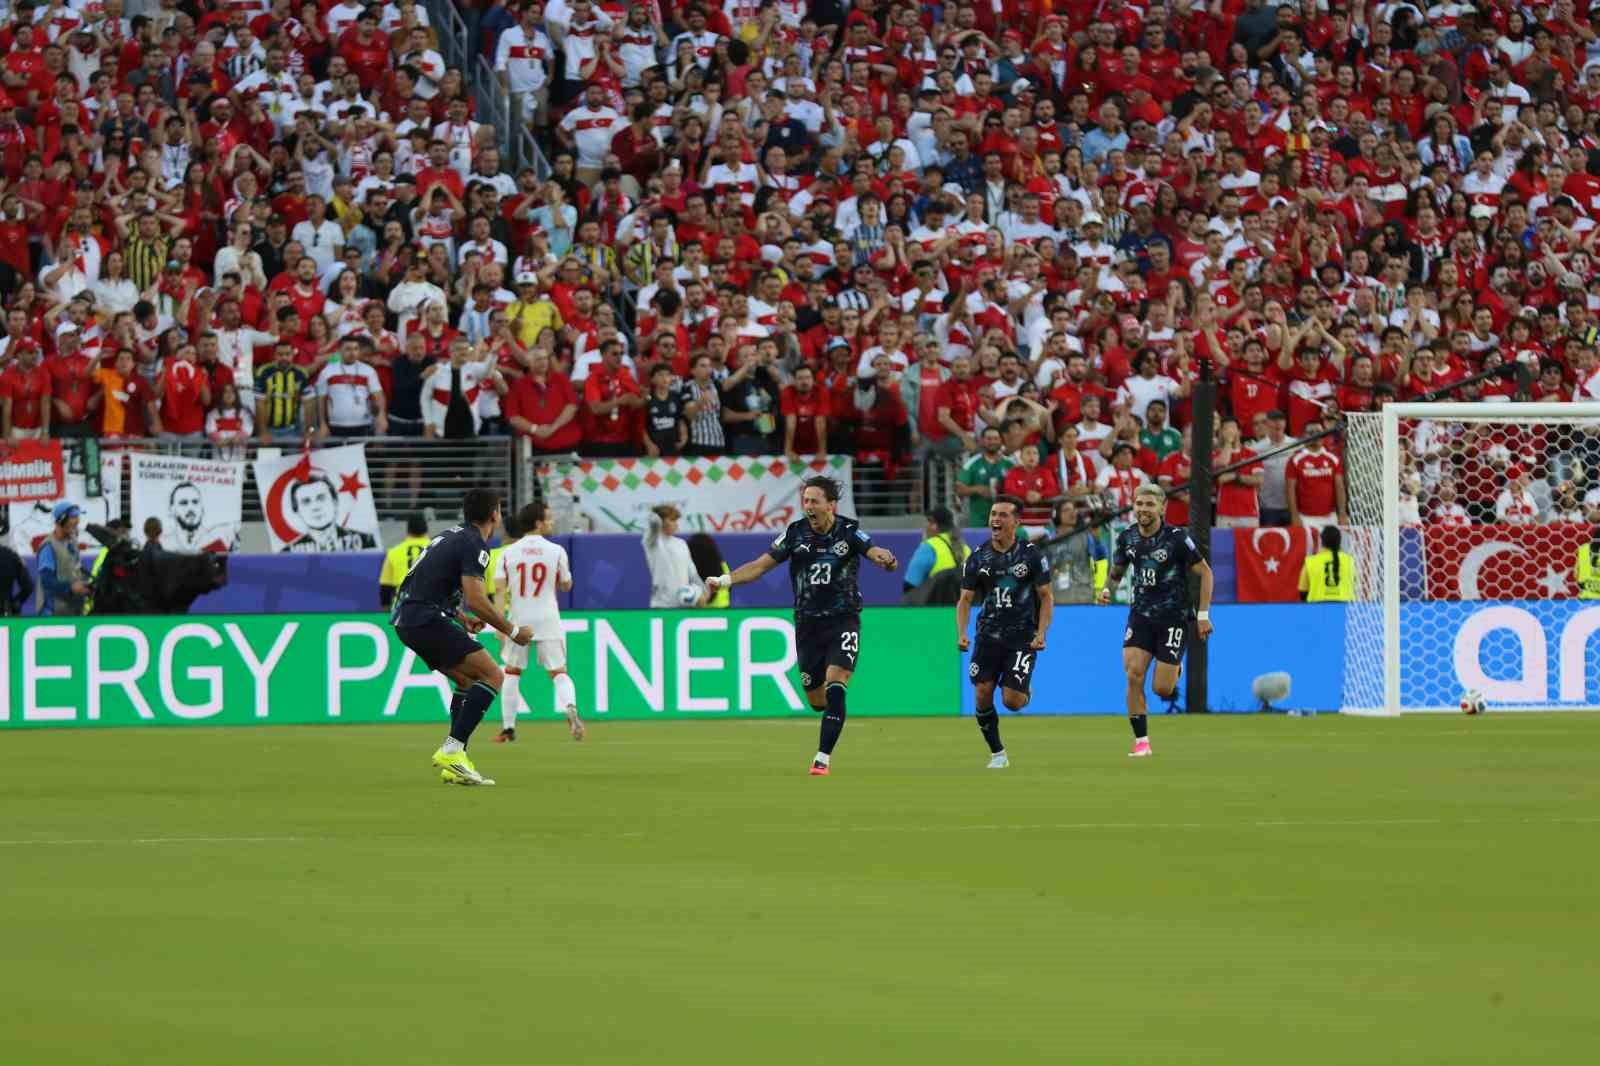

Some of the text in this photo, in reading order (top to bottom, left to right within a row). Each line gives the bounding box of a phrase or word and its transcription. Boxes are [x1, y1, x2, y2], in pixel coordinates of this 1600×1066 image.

[516, 562, 547, 597] 19
[810, 562, 831, 585] 23
[993, 586, 1013, 608] 14
[841, 631, 858, 652] 23
[1165, 627, 1183, 648] 19
[0, 622, 299, 721] ERGY
[1012, 651, 1031, 675] 14
